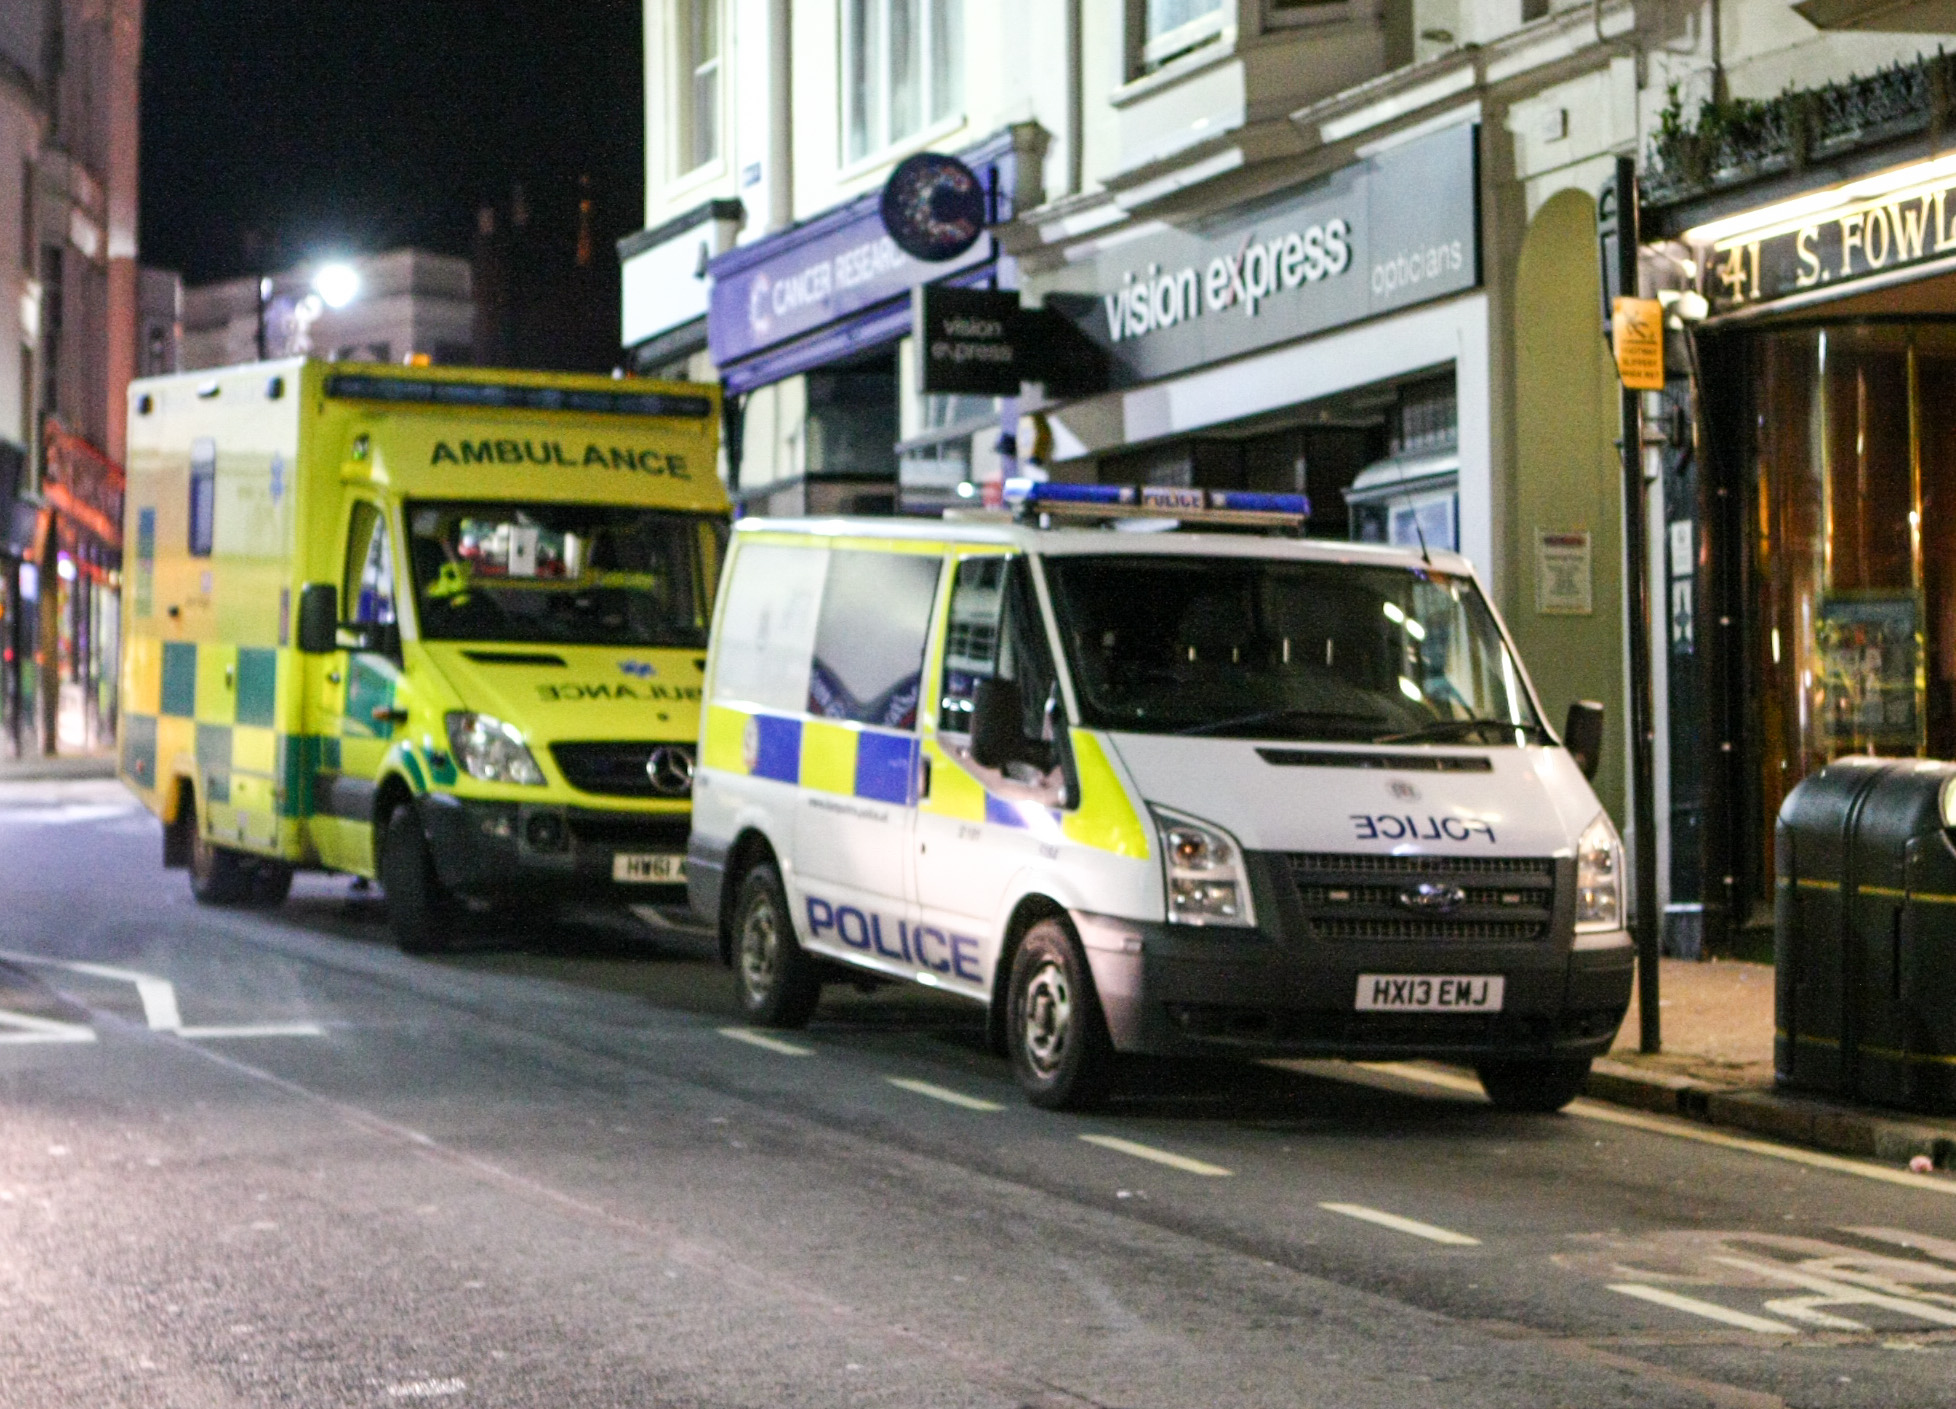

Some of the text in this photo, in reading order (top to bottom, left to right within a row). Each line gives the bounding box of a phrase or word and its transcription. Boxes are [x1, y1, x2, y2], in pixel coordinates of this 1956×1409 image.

[772, 261, 831, 315] CANCER
[834, 236, 907, 292] RESEARC
[1371, 238, 1463, 298] opticians
[1721, 190, 1956, 302] 41 S. FOWL
[1104, 217, 1350, 342] vision express
[931, 343, 1015, 363] express
[943, 318, 1003, 338] vision
[431, 440, 692, 480] AMBULANCE
[806, 894, 984, 984] POLICE
[1372, 979, 1489, 1006] HX13 EMJ
